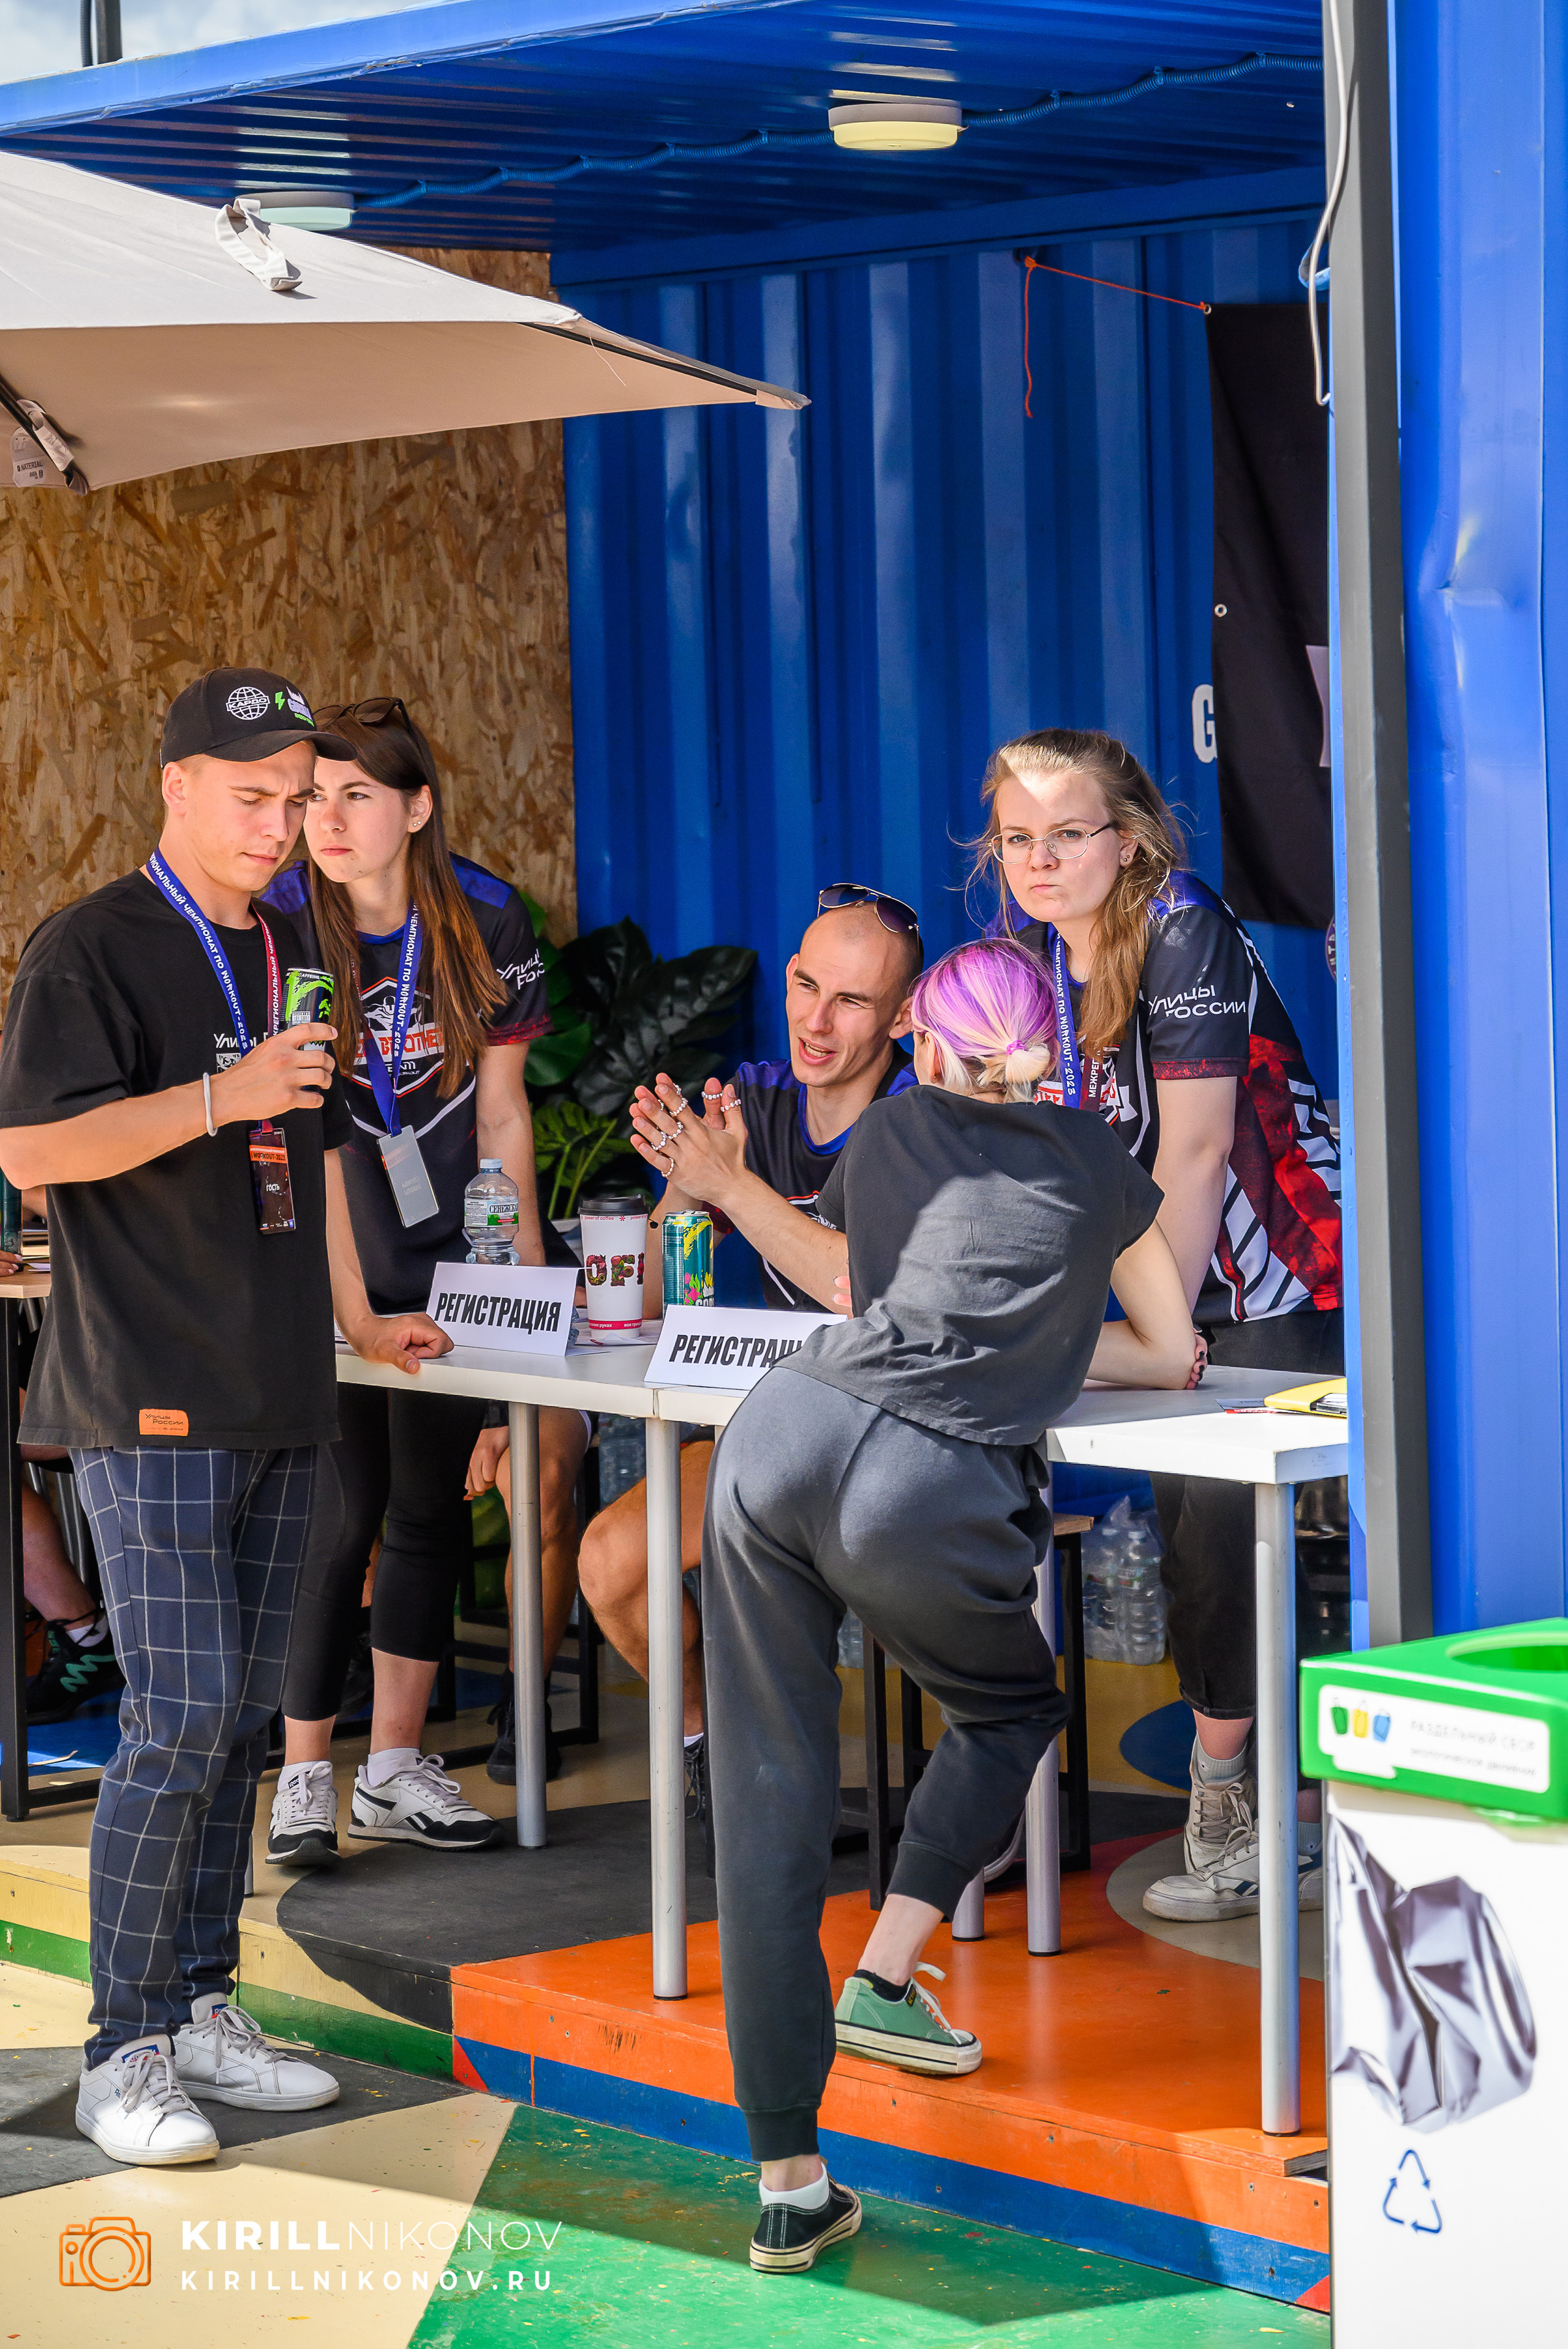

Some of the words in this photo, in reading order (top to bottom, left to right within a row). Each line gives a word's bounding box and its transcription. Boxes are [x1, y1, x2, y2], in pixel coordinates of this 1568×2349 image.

[228, 698, 267, 709] КАРДО
[184, 901, 218, 954] ЧЕМПИОНАТ
[213, 953, 225, 970] ПО
[404, 913, 418, 967] ЧЕМПИОНАТ
[402, 966, 412, 981] ПО
[1055, 940, 1065, 998] ЧЕМПИОНАТ
[1058, 1000, 1066, 1014] ПО
[1060, 1015, 1076, 1096] WORKOUT-2023
[266, 1183, 281, 1192] ГОСТЬ
[489, 1203, 519, 1213] СЕНЕЖСКА
[434, 1292, 562, 1335] РЕГИСТРАЦИЯ
